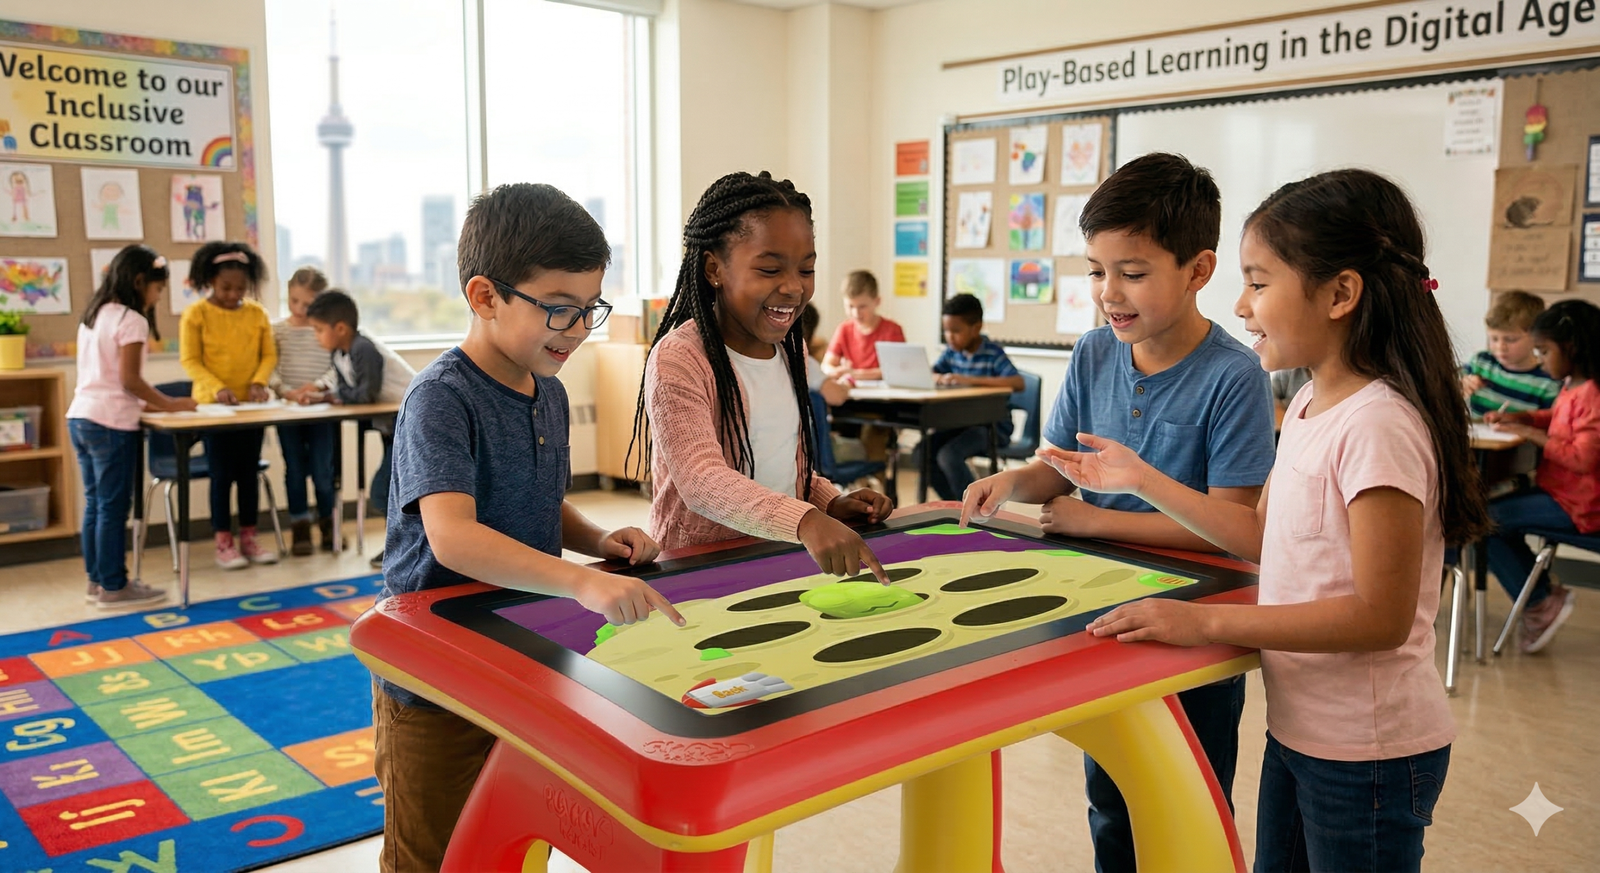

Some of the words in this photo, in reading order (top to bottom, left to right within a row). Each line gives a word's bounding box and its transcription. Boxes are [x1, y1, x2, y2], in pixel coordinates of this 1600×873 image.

[1003, 50, 1136, 97] Play-Based
[1147, 37, 1268, 76] Learning
[1281, 29, 1307, 60] in
[1320, 21, 1371, 54] the
[1385, 0, 1504, 52] Digital
[1518, 0, 1596, 37] Age
[138, 69, 166, 92] to
[177, 76, 223, 97] our
[45, 90, 184, 124] Inclusive
[30, 122, 192, 157] Classroom
[712, 685, 749, 699] Back
